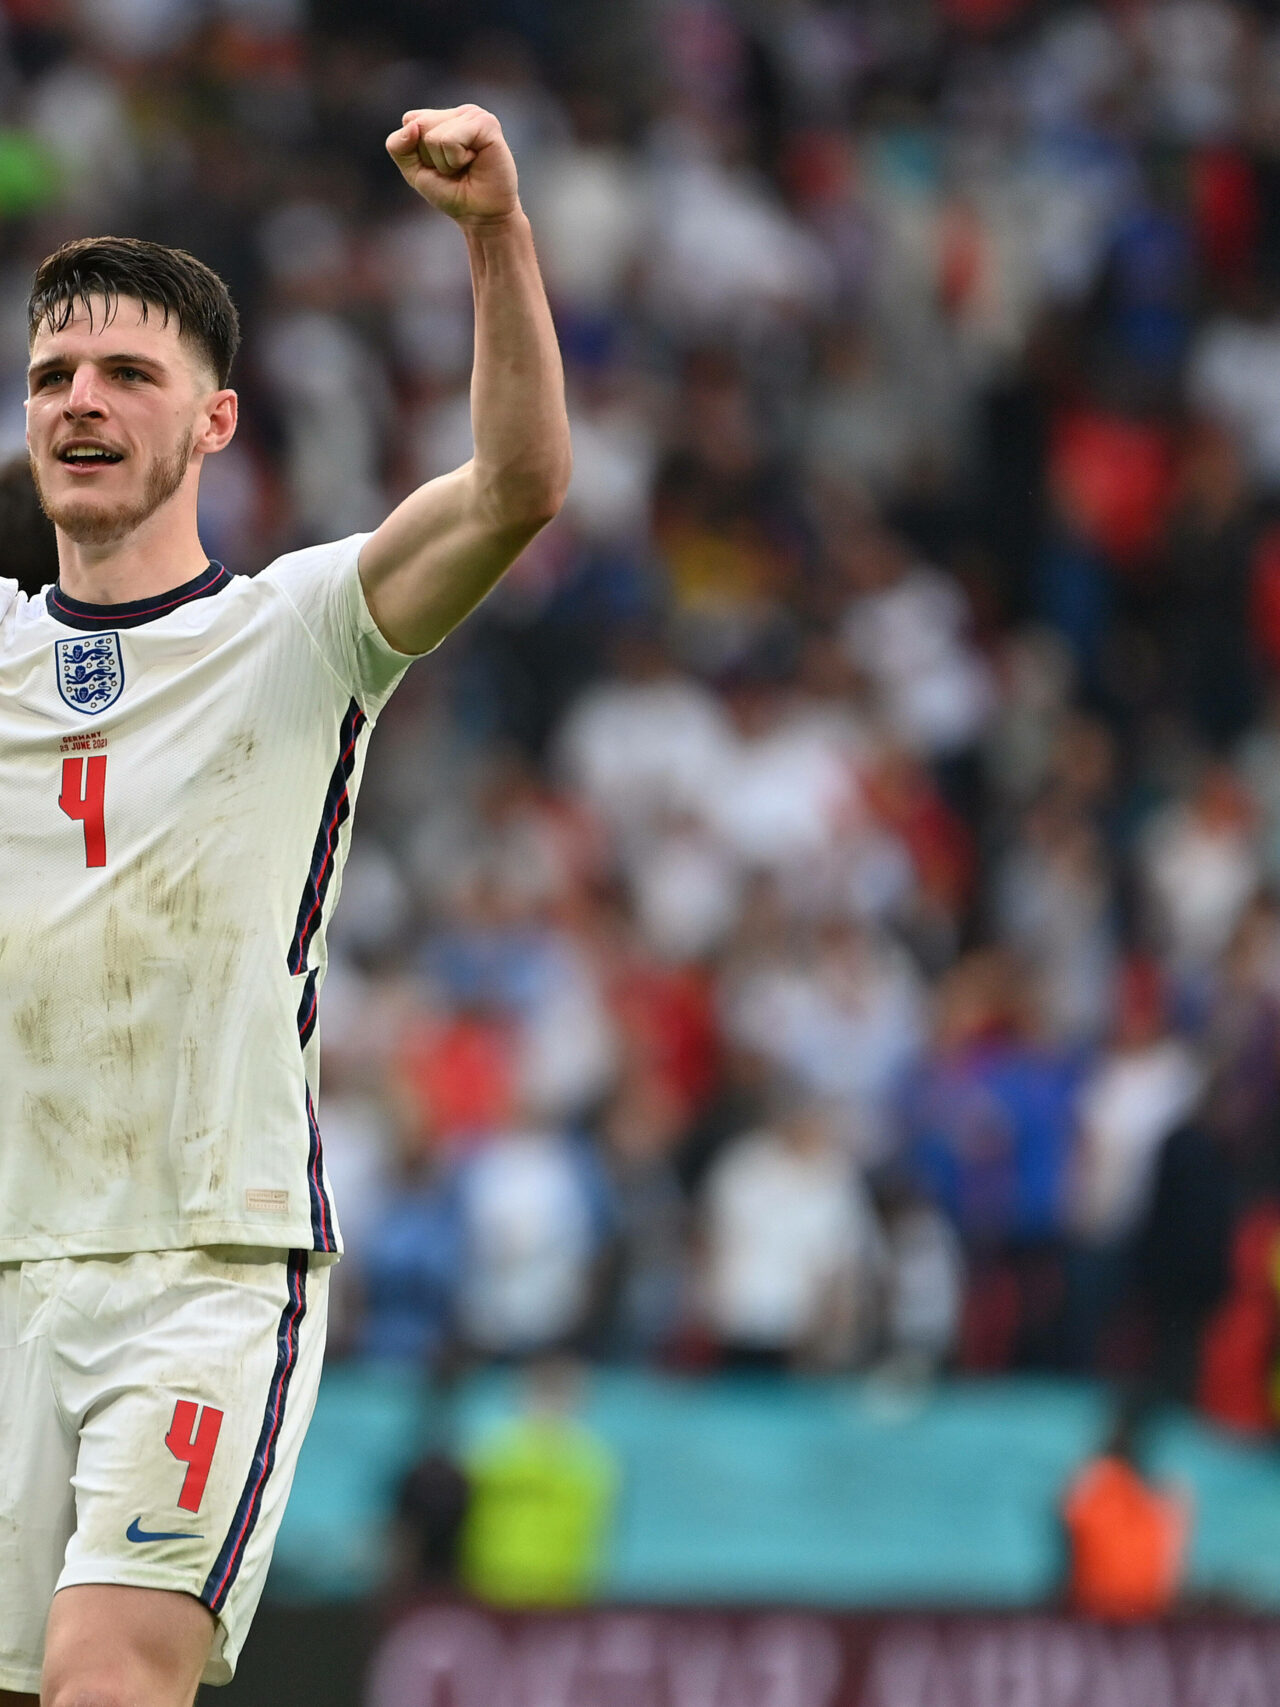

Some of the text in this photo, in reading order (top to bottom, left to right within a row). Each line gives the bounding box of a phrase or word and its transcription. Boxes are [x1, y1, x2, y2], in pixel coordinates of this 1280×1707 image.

[60, 738, 108, 752] 29 JUNE 2021
[62, 731, 101, 743] GERMANY
[58, 755, 107, 868] 4
[165, 1399, 224, 1514] 4
